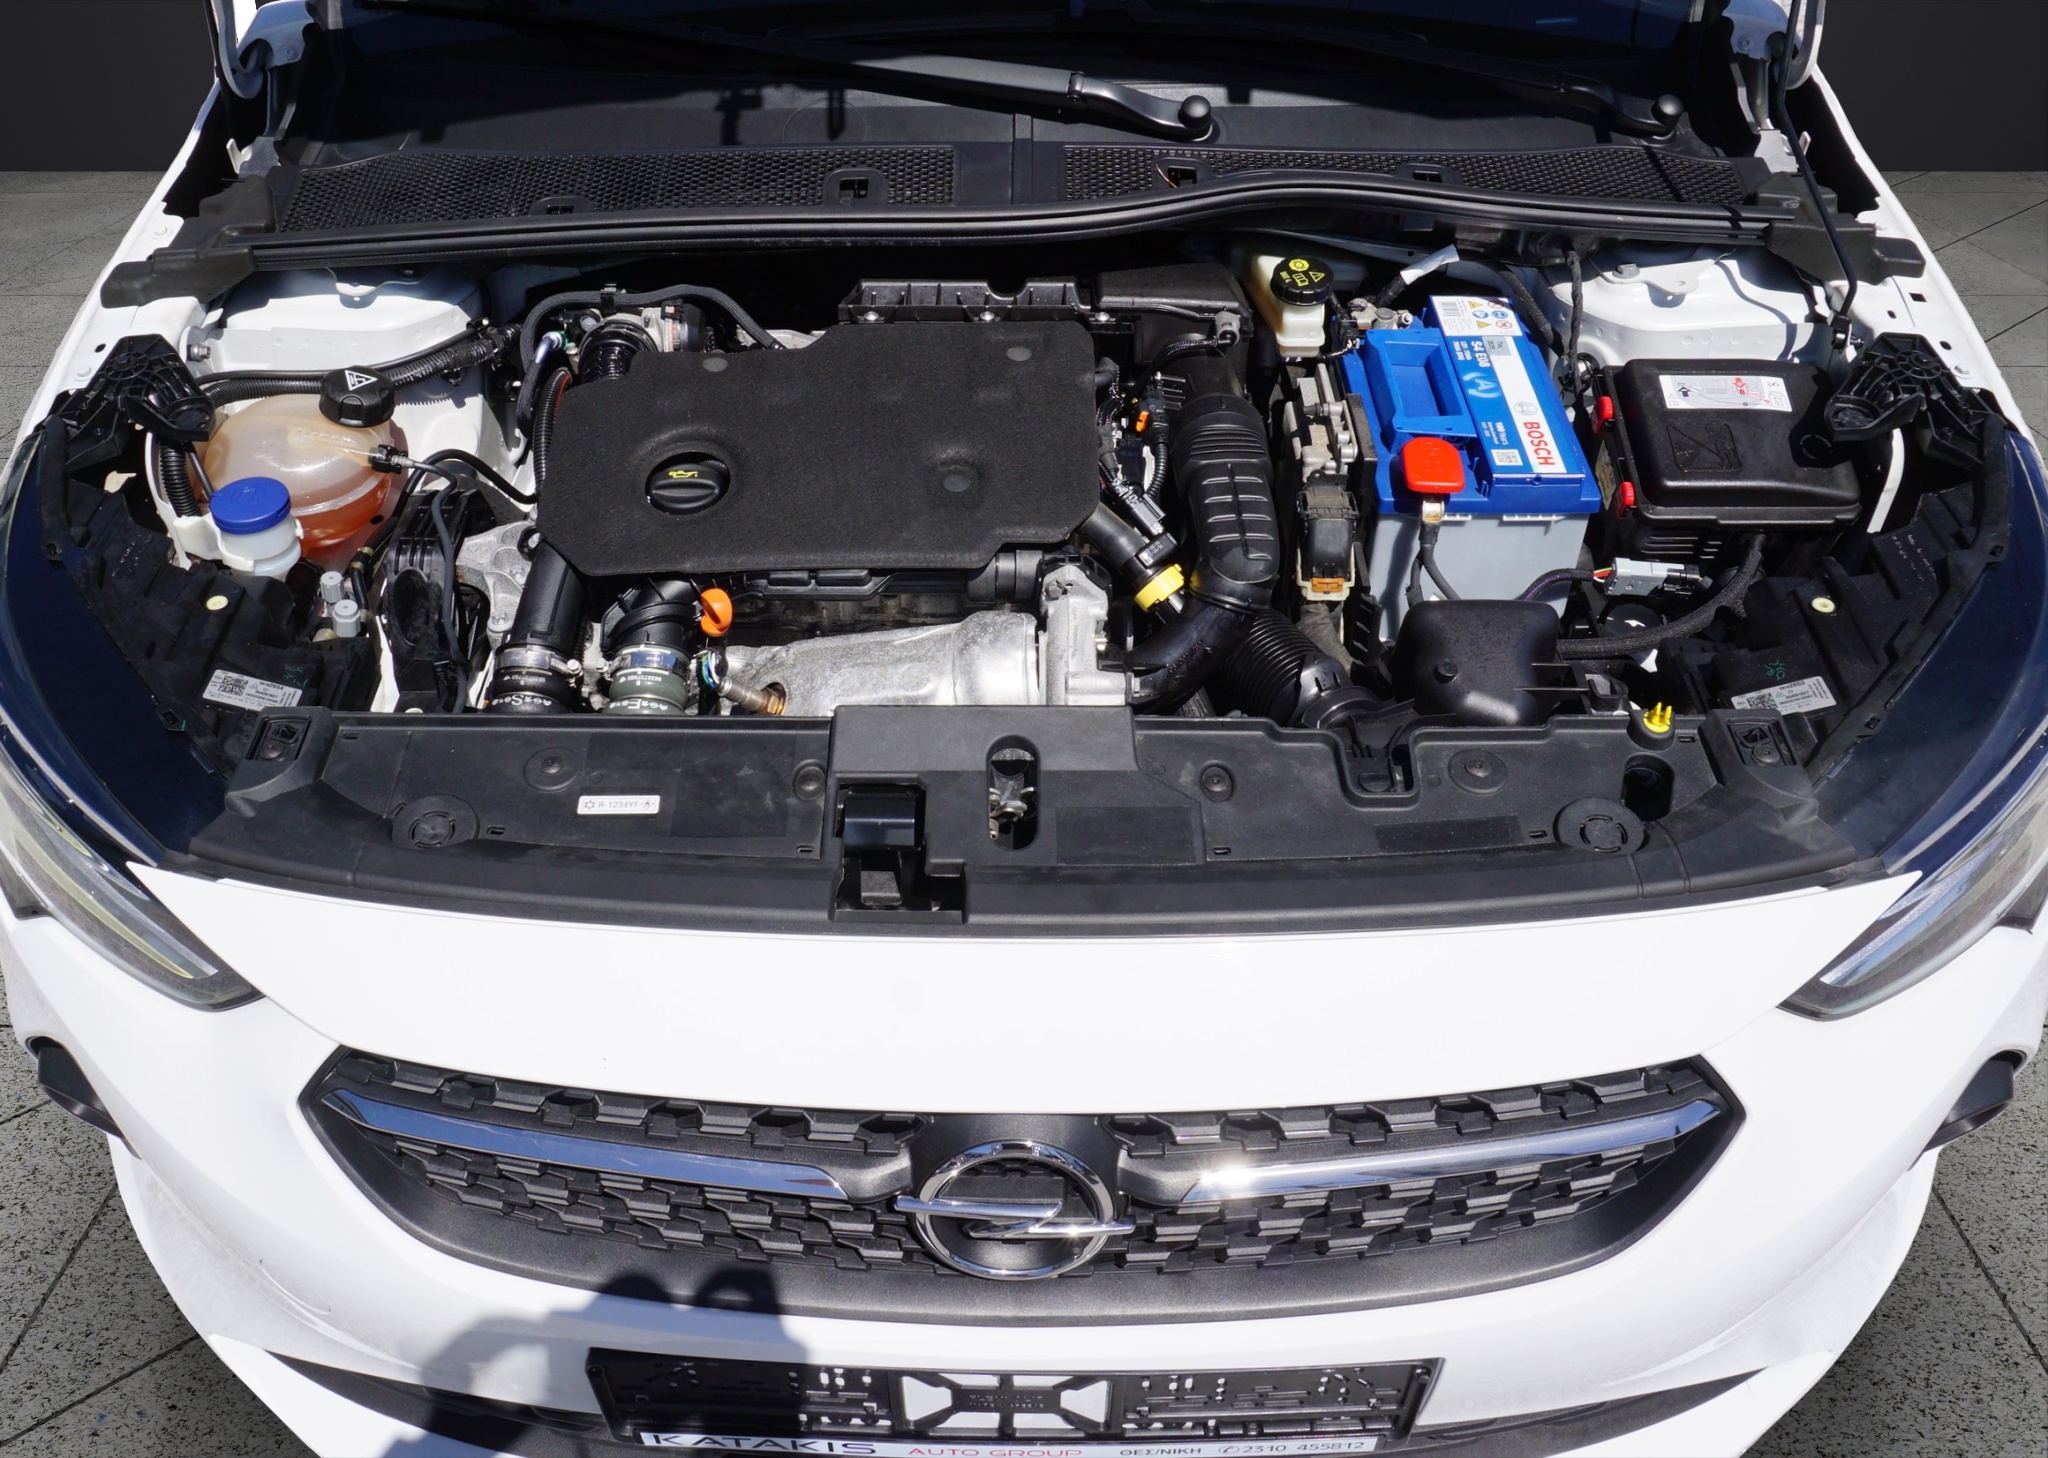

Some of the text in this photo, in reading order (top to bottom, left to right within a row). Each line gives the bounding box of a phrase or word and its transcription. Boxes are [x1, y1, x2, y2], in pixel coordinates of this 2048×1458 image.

[1471, 341, 1490, 367] S4 E08
[1523, 421, 1555, 466] BOSCH
[597, 800, 640, 809] R-1234YF
[653, 1434, 1082, 1457] KATAKIS AUTO GROUP
[1243, 1441, 1364, 1454] 2310 455812
